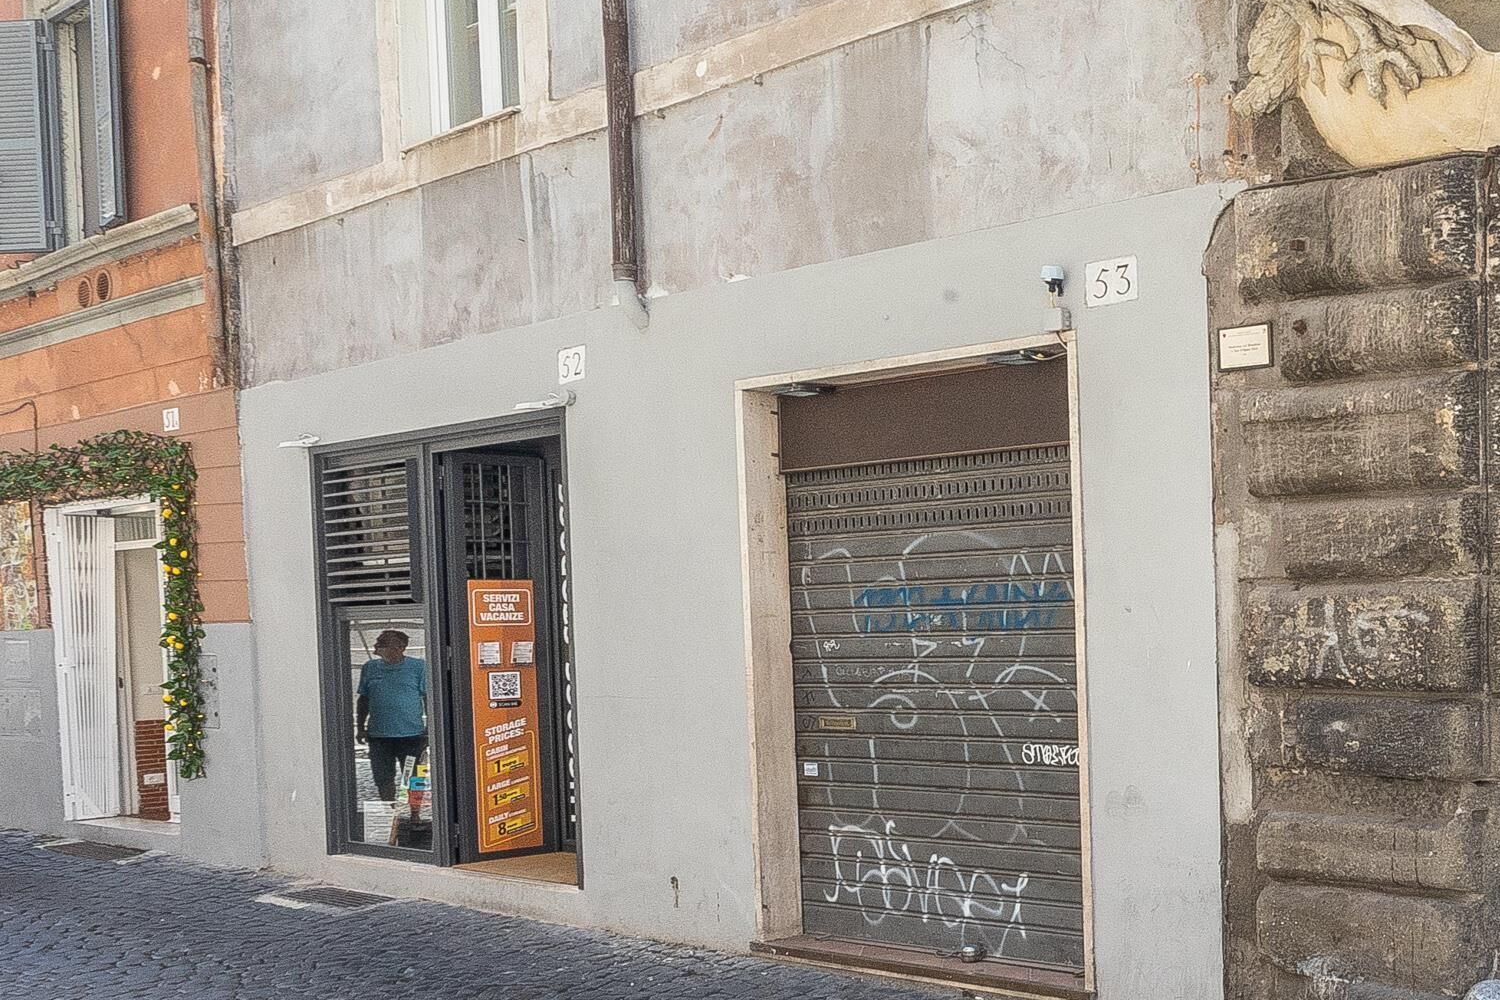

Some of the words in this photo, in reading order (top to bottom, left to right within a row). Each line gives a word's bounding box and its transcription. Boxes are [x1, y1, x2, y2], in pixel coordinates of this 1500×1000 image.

[1092, 263, 1131, 299] 53
[561, 351, 583, 379] 52
[482, 593, 520, 603] SERVIZI
[488, 603, 516, 612] CASA
[479, 612, 524, 621] VACANZE
[484, 717, 528, 737] STORAGE
[498, 822, 507, 836] 8
